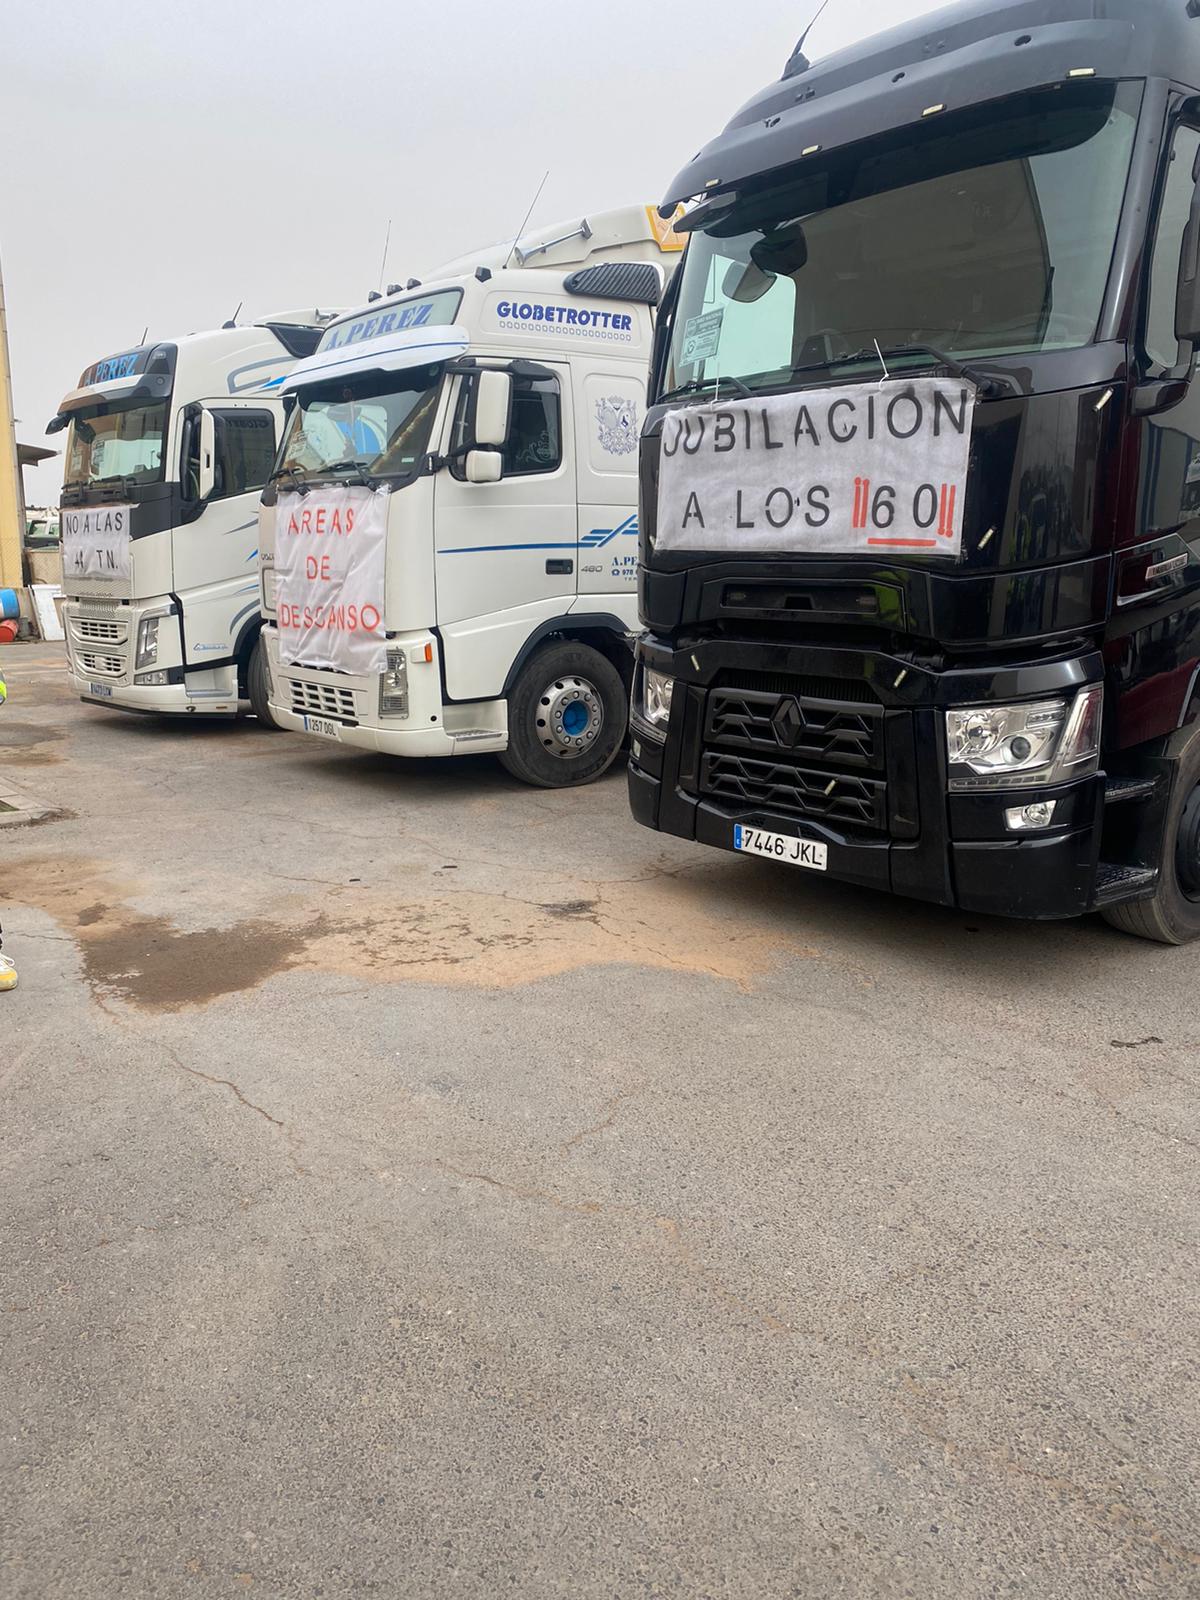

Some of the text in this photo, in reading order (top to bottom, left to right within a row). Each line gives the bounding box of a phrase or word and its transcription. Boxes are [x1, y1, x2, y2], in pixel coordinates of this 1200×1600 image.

[496, 301, 632, 330] GLOBETROTTER
[682, 491, 705, 529] A
[736, 485, 830, 528] LOS
[66, 512, 123, 535] NO A LAS
[287, 508, 354, 535] AREAS
[306, 556, 331, 580] DE
[281, 604, 381, 632] DESCANSO
[745, 830, 822, 865] 7446 JKL
